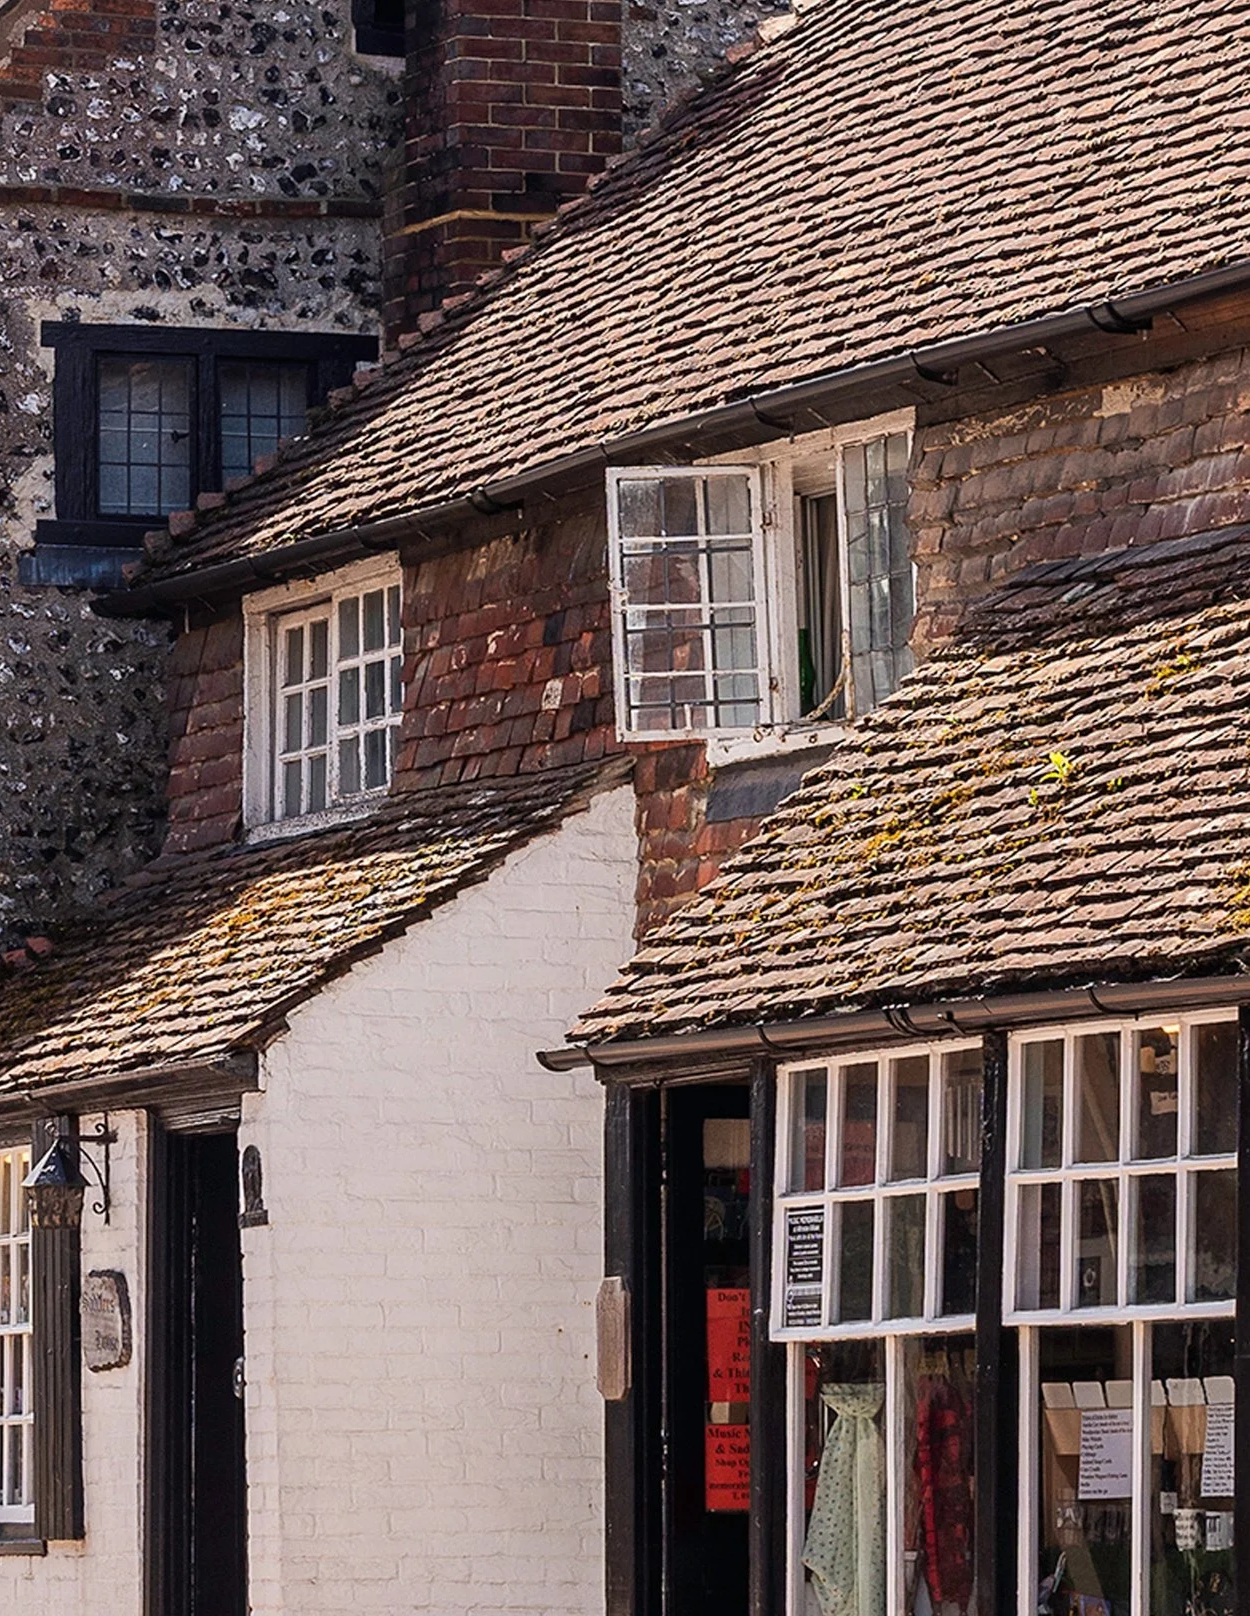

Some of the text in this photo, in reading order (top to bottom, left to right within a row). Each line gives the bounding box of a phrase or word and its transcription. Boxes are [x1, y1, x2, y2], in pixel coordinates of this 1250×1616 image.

[718, 1292, 746, 1302] Don't
[713, 1368, 723, 1378] &
[709, 1428, 741, 1438] Music
[715, 1443, 725, 1453] &
